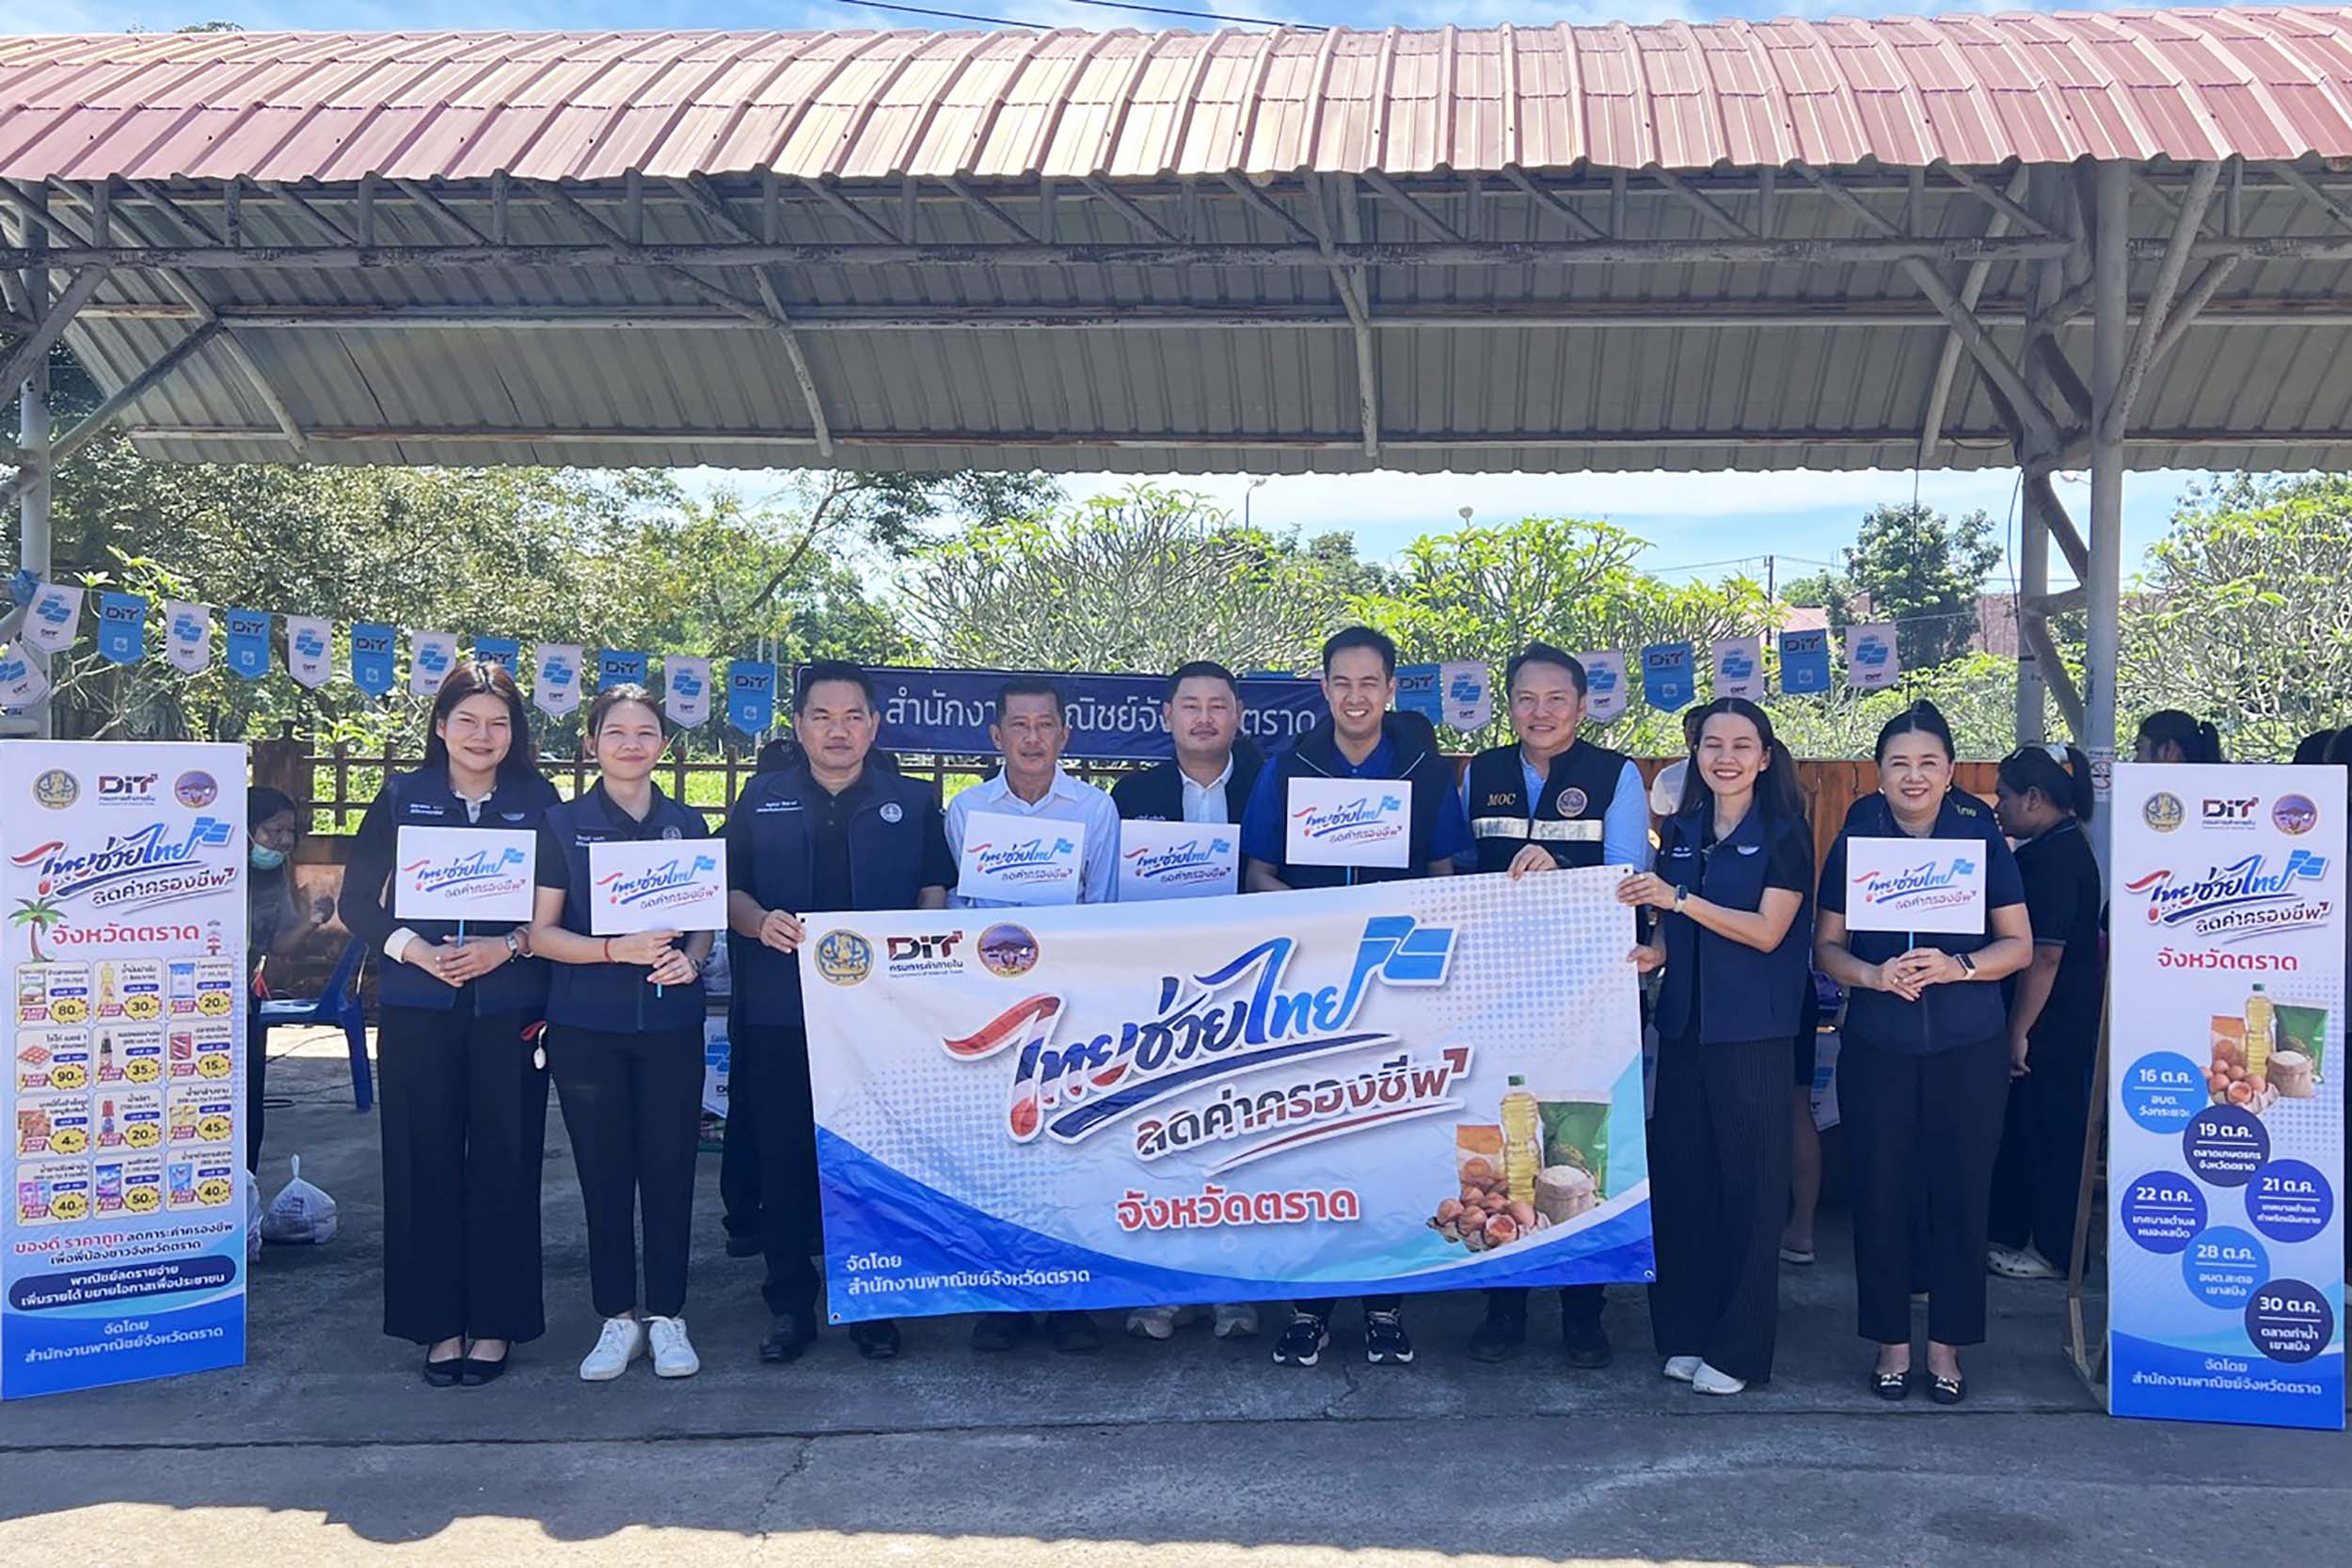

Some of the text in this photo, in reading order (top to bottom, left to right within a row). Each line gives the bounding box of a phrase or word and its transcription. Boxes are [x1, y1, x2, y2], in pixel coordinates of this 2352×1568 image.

[104, 606, 140, 621] DiT
[231, 620, 264, 634] DiT
[356, 637, 389, 651] DiT
[1784, 636, 1822, 652] DiT
[1649, 650, 1685, 666] DiT
[605, 661, 639, 674] DiT
[735, 675, 770, 688] DiT
[1399, 674, 1435, 689] DiT
[99, 774, 158, 794] DiT
[1486, 793, 1517, 806] MOC
[2202, 797, 2260, 817] DiT
[52, 922, 200, 946] จังหวัดตราด
[887, 930, 963, 961] DiT
[2157, 947, 2298, 972] จังหวัดตราด
[944, 917, 1392, 1135] ไทยช่วยไทย
[2139, 1069, 2192, 1084] 16 ต.ค.
[1136, 1048, 1463, 1155] ลดค่าครองชีพ
[2199, 1123, 2253, 1138] 19 ต.ค.
[2263, 1178, 2315, 1193] 21 ต.ค.
[2136, 1187, 2192, 1203] 22 ต.ค.
[1118, 1186, 1359, 1230] จังหวัดตราด
[15, 1239, 61, 1255] ของดี
[64, 1233, 124, 1250] ราคาถูก
[50, 1240, 201, 1265] เพื่อพี่น้องชาวจังหวัดตราด
[2197, 1244, 2256, 1260] 28 ต.ค.
[847, 1252, 902, 1272] จัดโดย
[71, 1264, 180, 1287] พาณิชย์ลดรายจ่าย
[849, 1268, 1090, 1295] สำนักงานพาณิชย์จังหวัดตราด
[21, 1274, 225, 1307] เพิ่มรายได้ ขยายโอกาสเพื่อประชาชน
[2259, 1296, 2321, 1313] 30 ต.ค.
[103, 1319, 150, 1335] จัดโดย
[24, 1324, 224, 1363] สำนักงานพาณิชย์จังหวัดตราด
[2204, 1357, 2248, 1372] จัดโดย
[2132, 1370, 2323, 1395] สำนักงานพาณิชย์จังหวัดตราด
